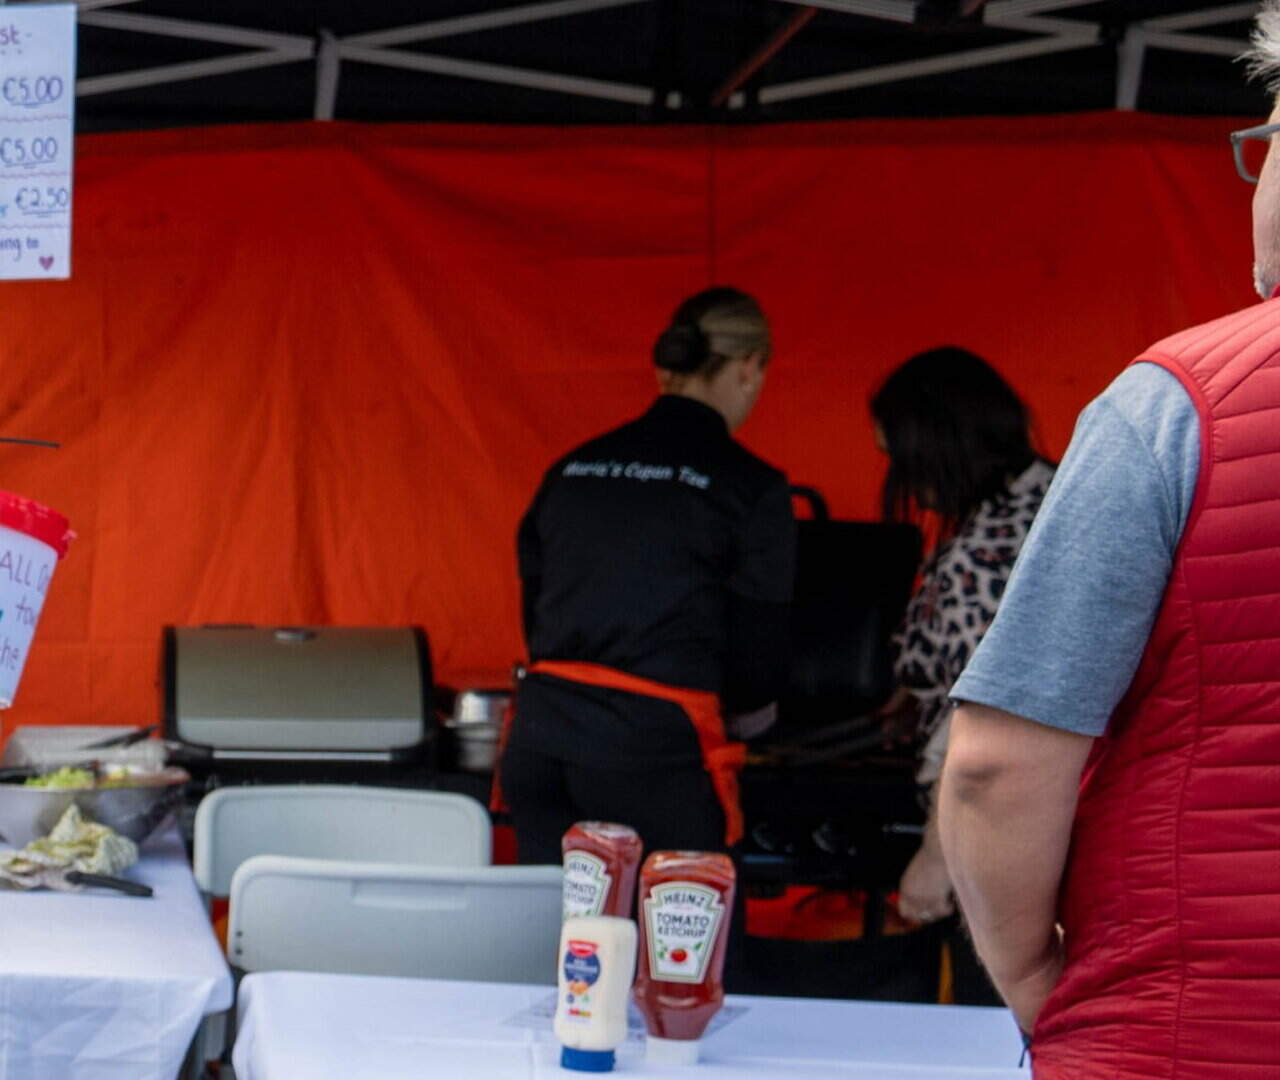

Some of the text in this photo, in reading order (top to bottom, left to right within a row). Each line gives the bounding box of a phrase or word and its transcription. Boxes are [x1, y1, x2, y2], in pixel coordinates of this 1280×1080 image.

[26, 236, 40, 249] to
[662, 892, 707, 905] HEINZ
[656, 911, 710, 929] TOMATO
[657, 926, 707, 939] KETCHUP
